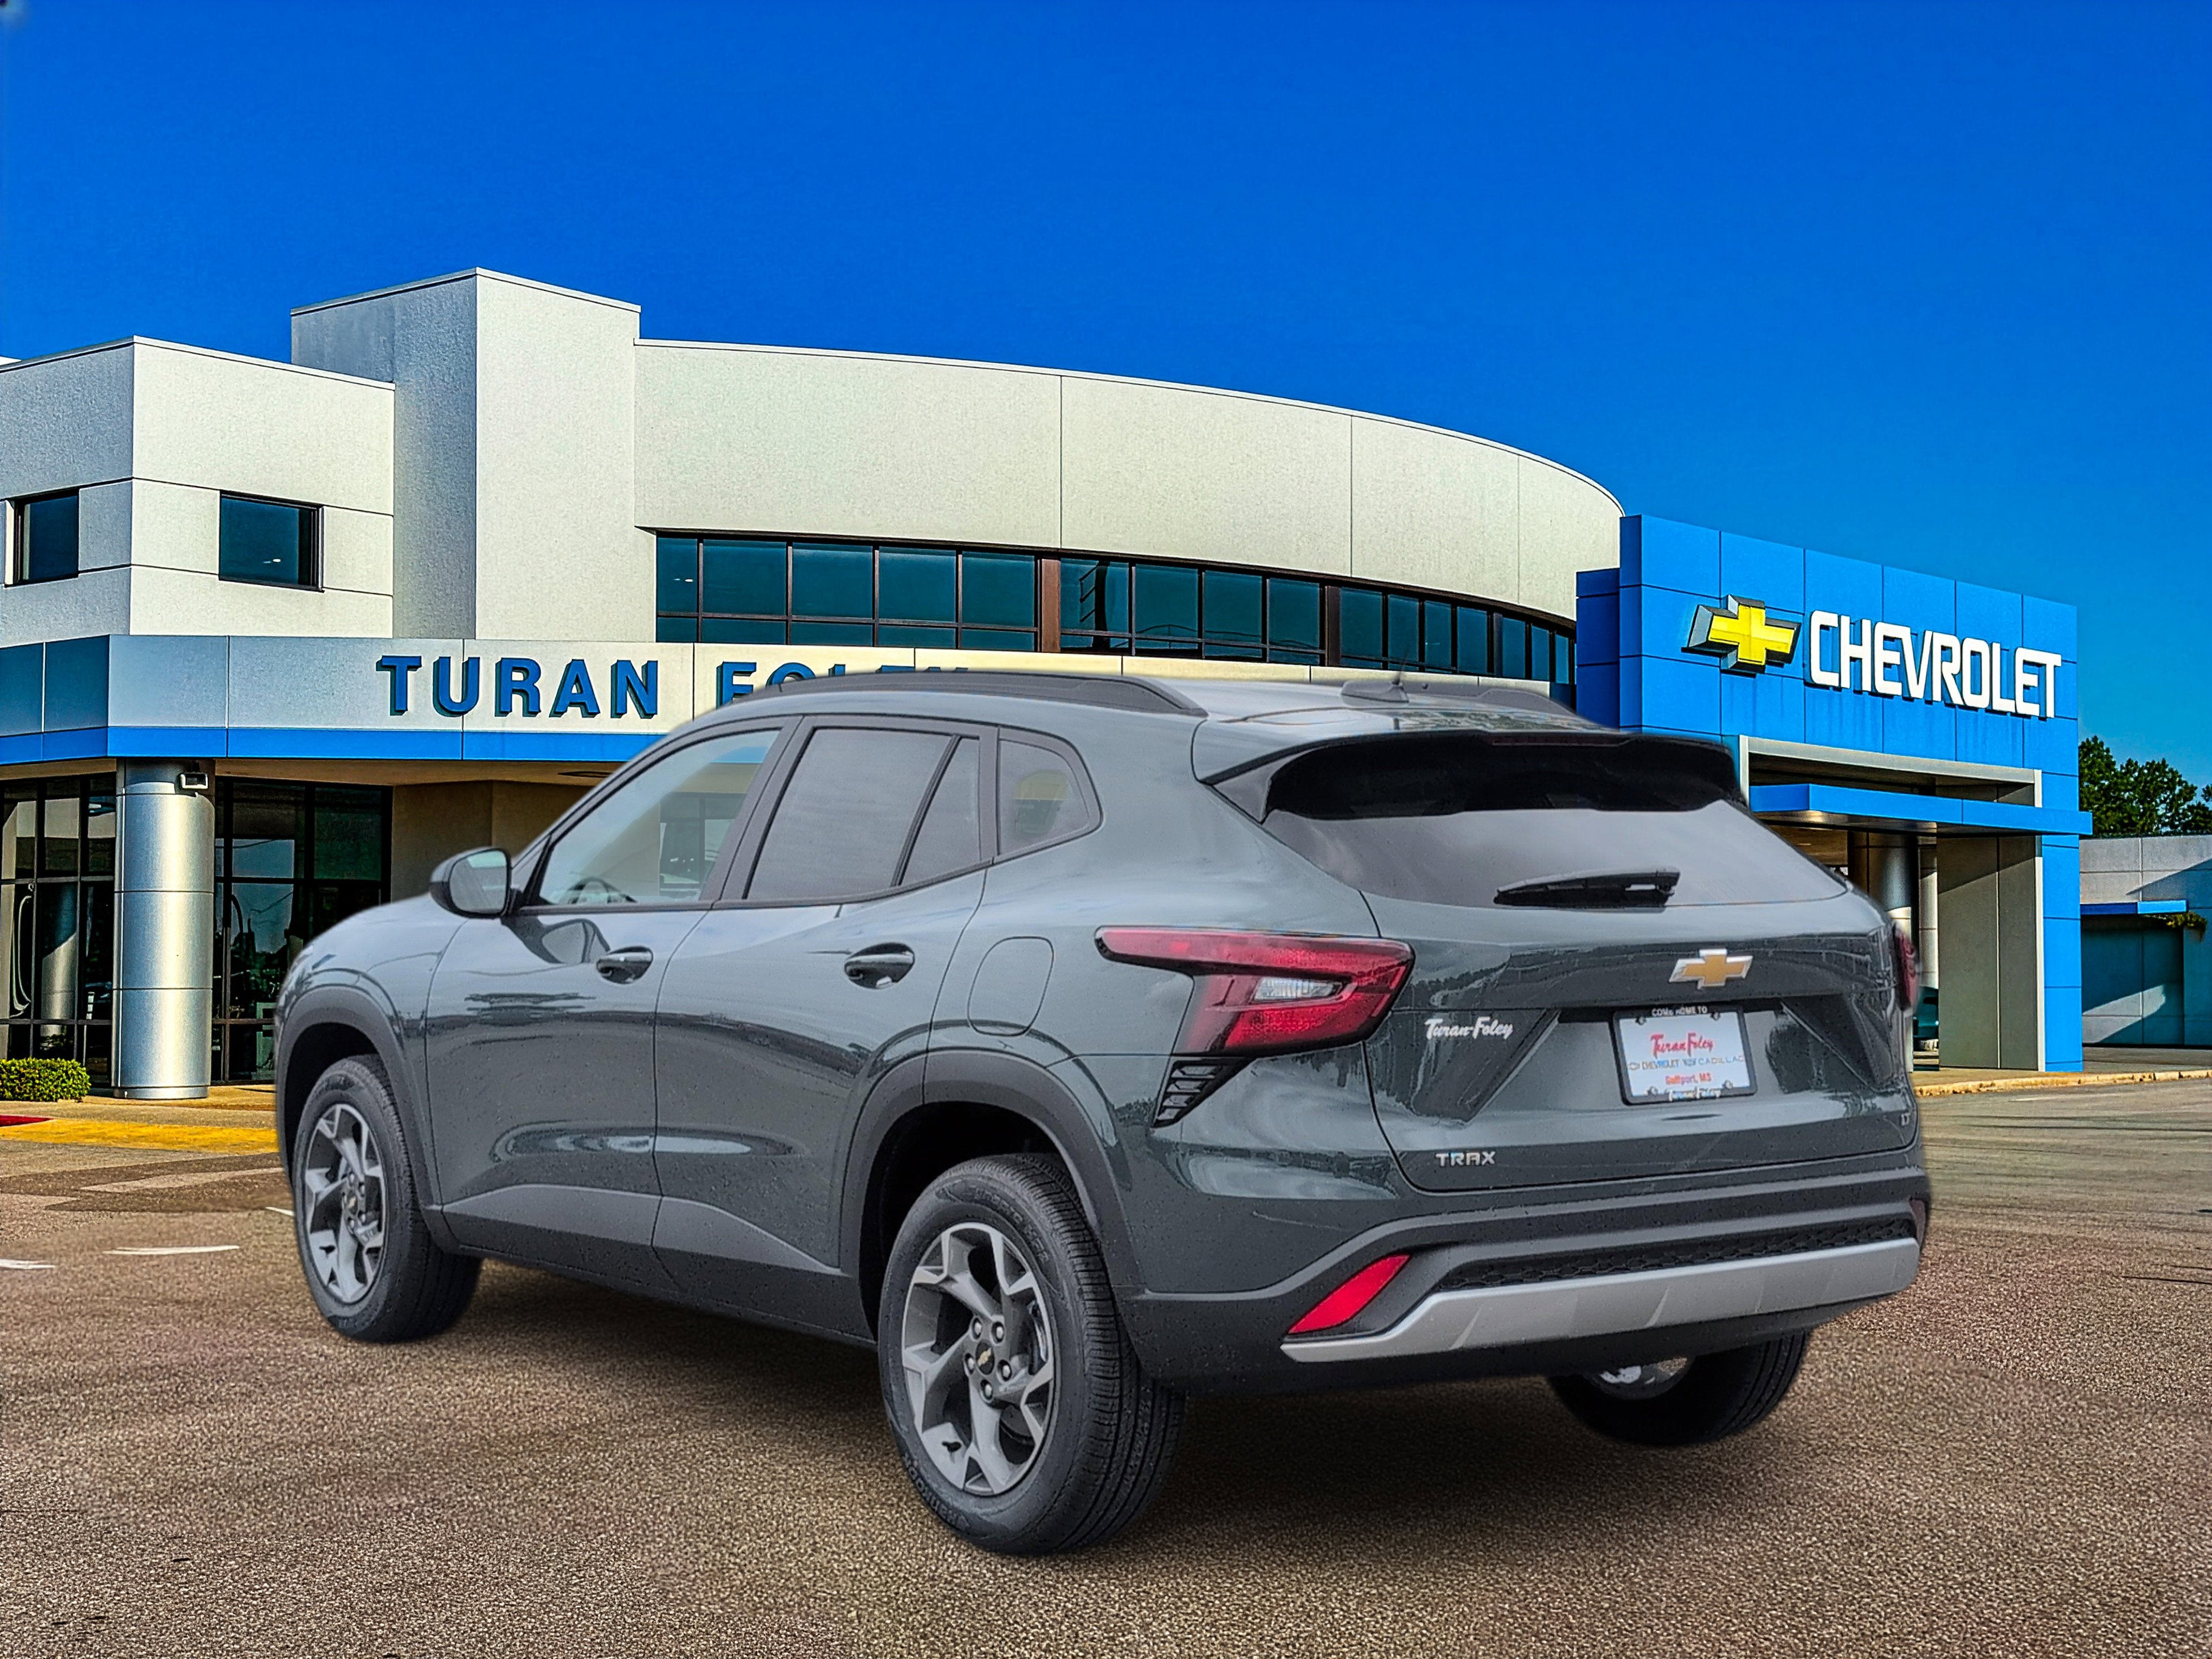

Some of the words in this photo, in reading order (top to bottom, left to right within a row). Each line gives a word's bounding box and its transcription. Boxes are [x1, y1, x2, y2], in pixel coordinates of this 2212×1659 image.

[1809, 610, 2062, 719] CHEVROLET
[376, 655, 658, 719] TURAN
[1697, 1005, 1708, 1014] TO
[1425, 1018, 1472, 1040] Turan
[1472, 1016, 1514, 1039] Foley
[1650, 1033, 1686, 1059] Turan
[1687, 1032, 1714, 1057] Foley
[1436, 1150, 1496, 1166] TRAX
